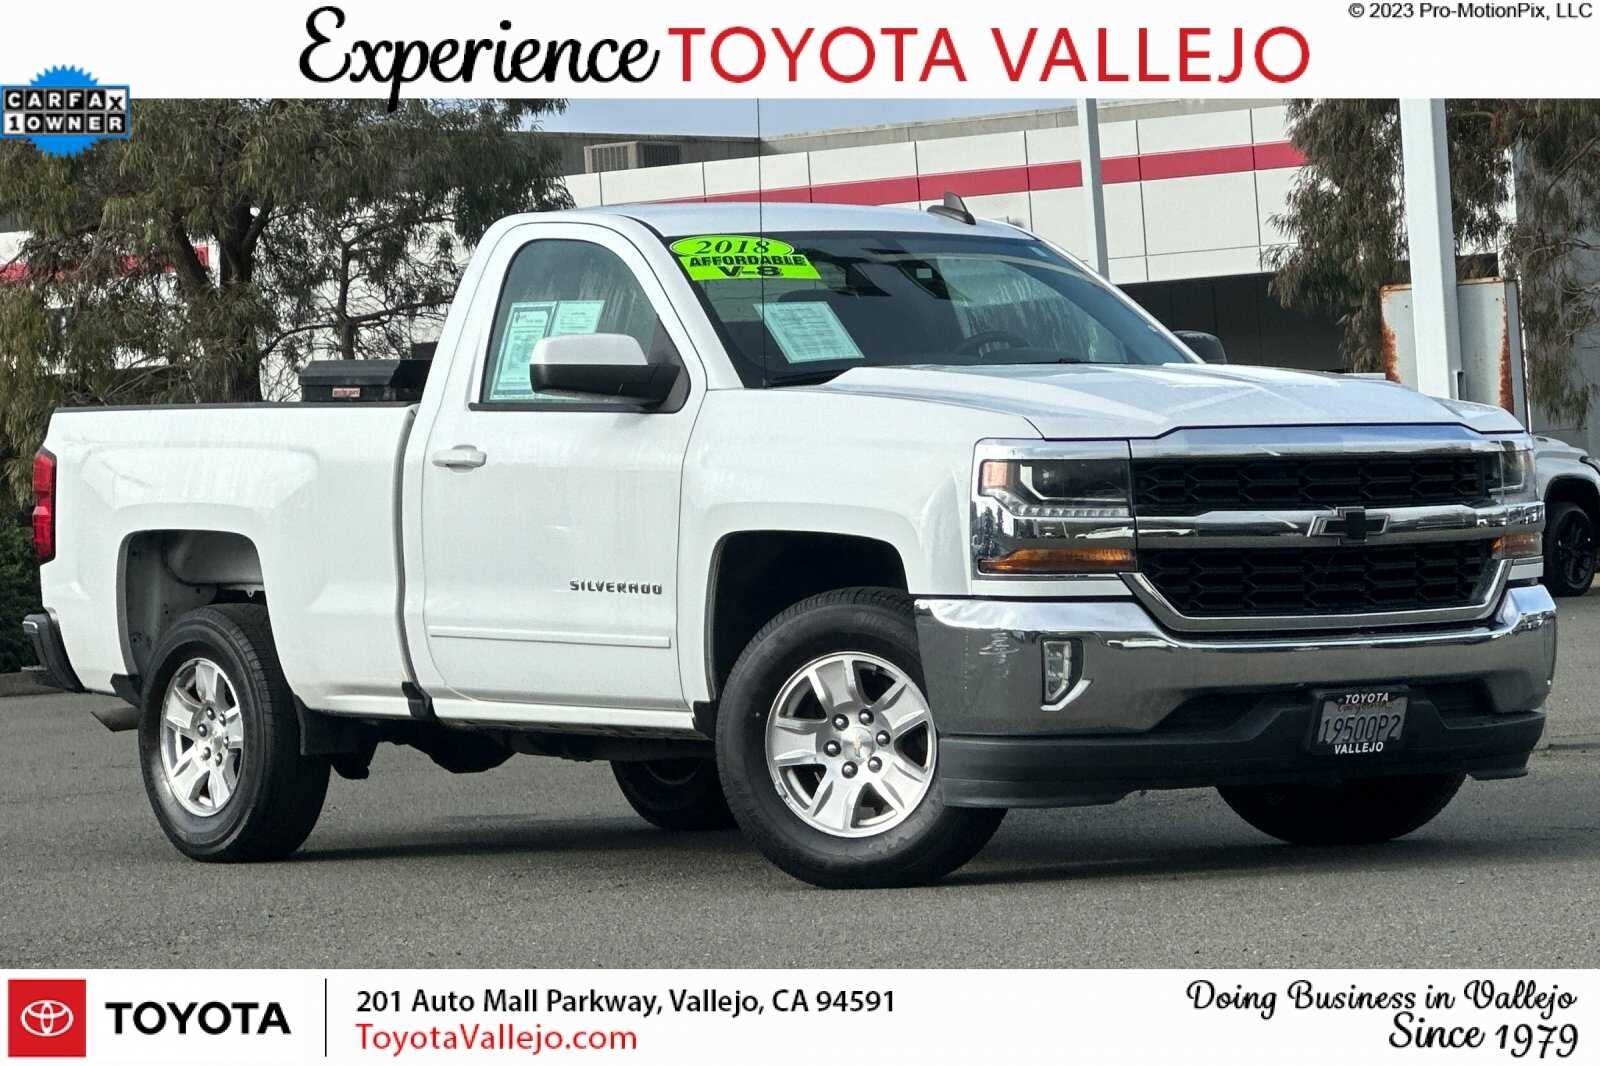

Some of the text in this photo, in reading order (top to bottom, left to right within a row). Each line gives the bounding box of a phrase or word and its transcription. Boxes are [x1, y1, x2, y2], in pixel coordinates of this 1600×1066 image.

[694, 240, 770, 254] 2018
[689, 255, 807, 267] AFFORDABLE
[720, 265, 783, 277] V-8
[569, 580, 663, 595] SILVERADO
[1345, 692, 1389, 704] TOYOTA
[1320, 714, 1401, 744] 19500P2
[1334, 741, 1384, 754] VALLEJO
